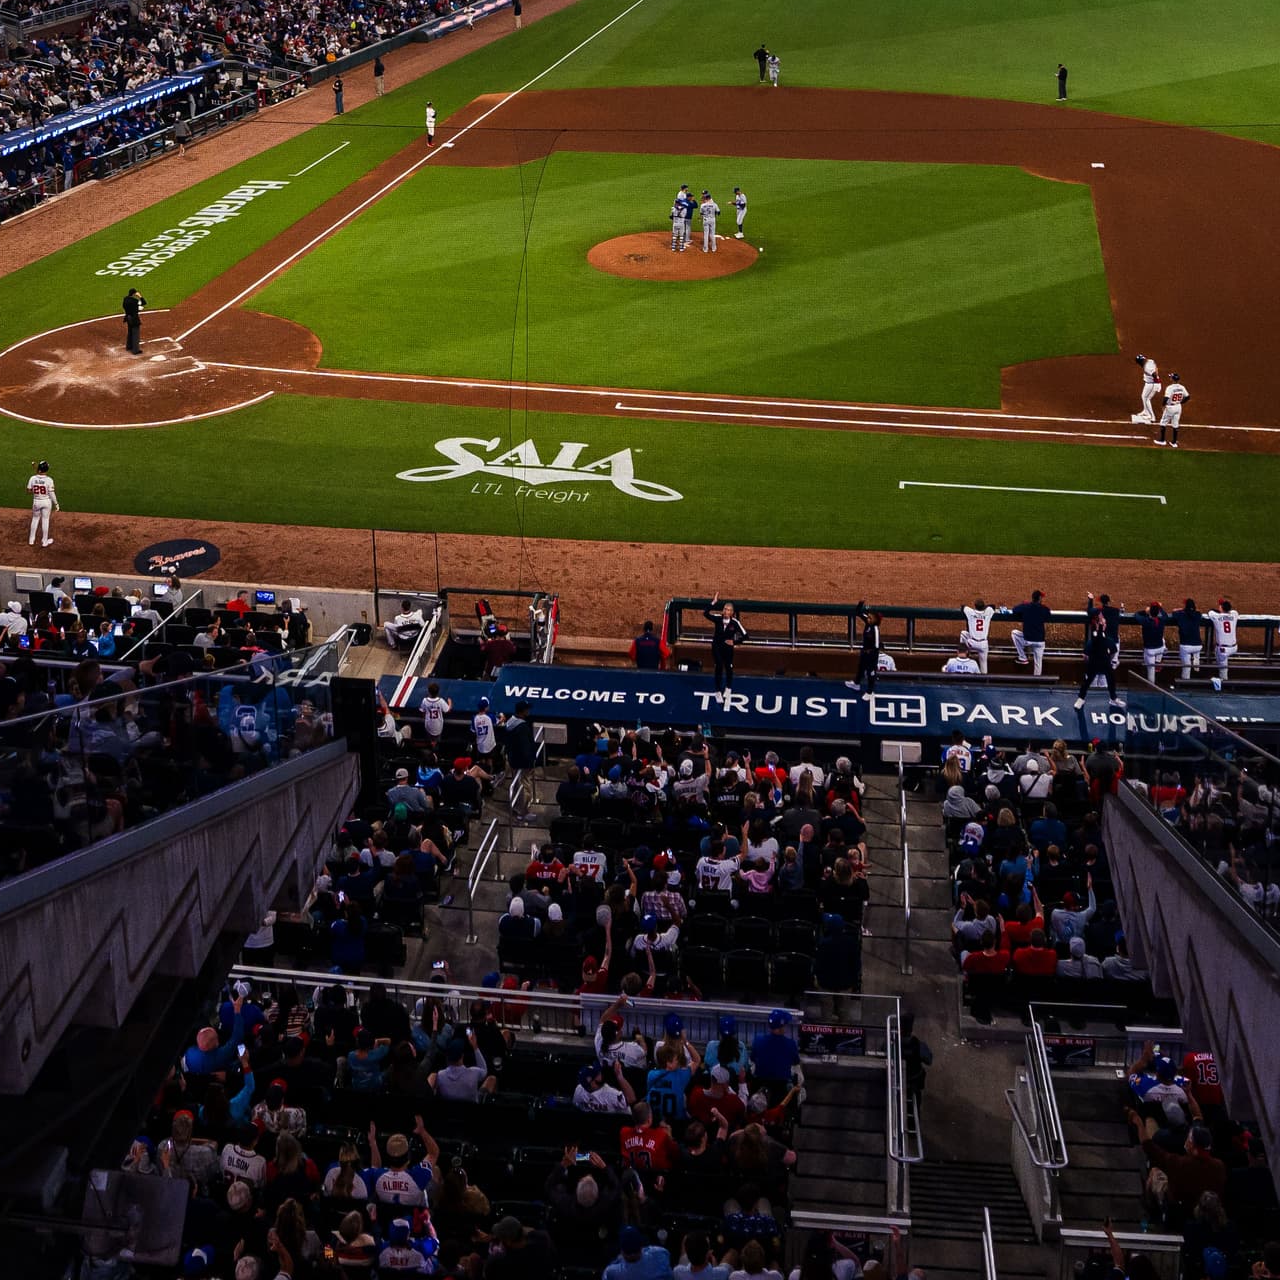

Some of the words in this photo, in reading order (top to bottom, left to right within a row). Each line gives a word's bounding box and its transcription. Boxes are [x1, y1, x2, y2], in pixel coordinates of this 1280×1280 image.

[95, 228, 188, 276] CASINOS
[120, 228, 211, 277] CHEROKEE
[395, 437, 684, 502] SAIA
[33, 485, 46, 495] 28
[471, 482, 503, 496] LTL
[515, 485, 591, 504] Freight
[976, 619, 984, 632] 2
[1223, 621, 1231, 634] 8
[505, 684, 627, 704] WELCOME
[634, 692, 666, 706] TO
[428, 708, 439, 721] 13
[693, 687, 858, 718] TRUIST
[940, 701, 1064, 727] PARK
[477, 724, 489, 737] 27
[801, 1025, 833, 1034] CAUTION
[845, 1027, 864, 1035] ALERT
[226, 1156, 250, 1172] OLSON
[382, 1180, 410, 1194] ALBIES
